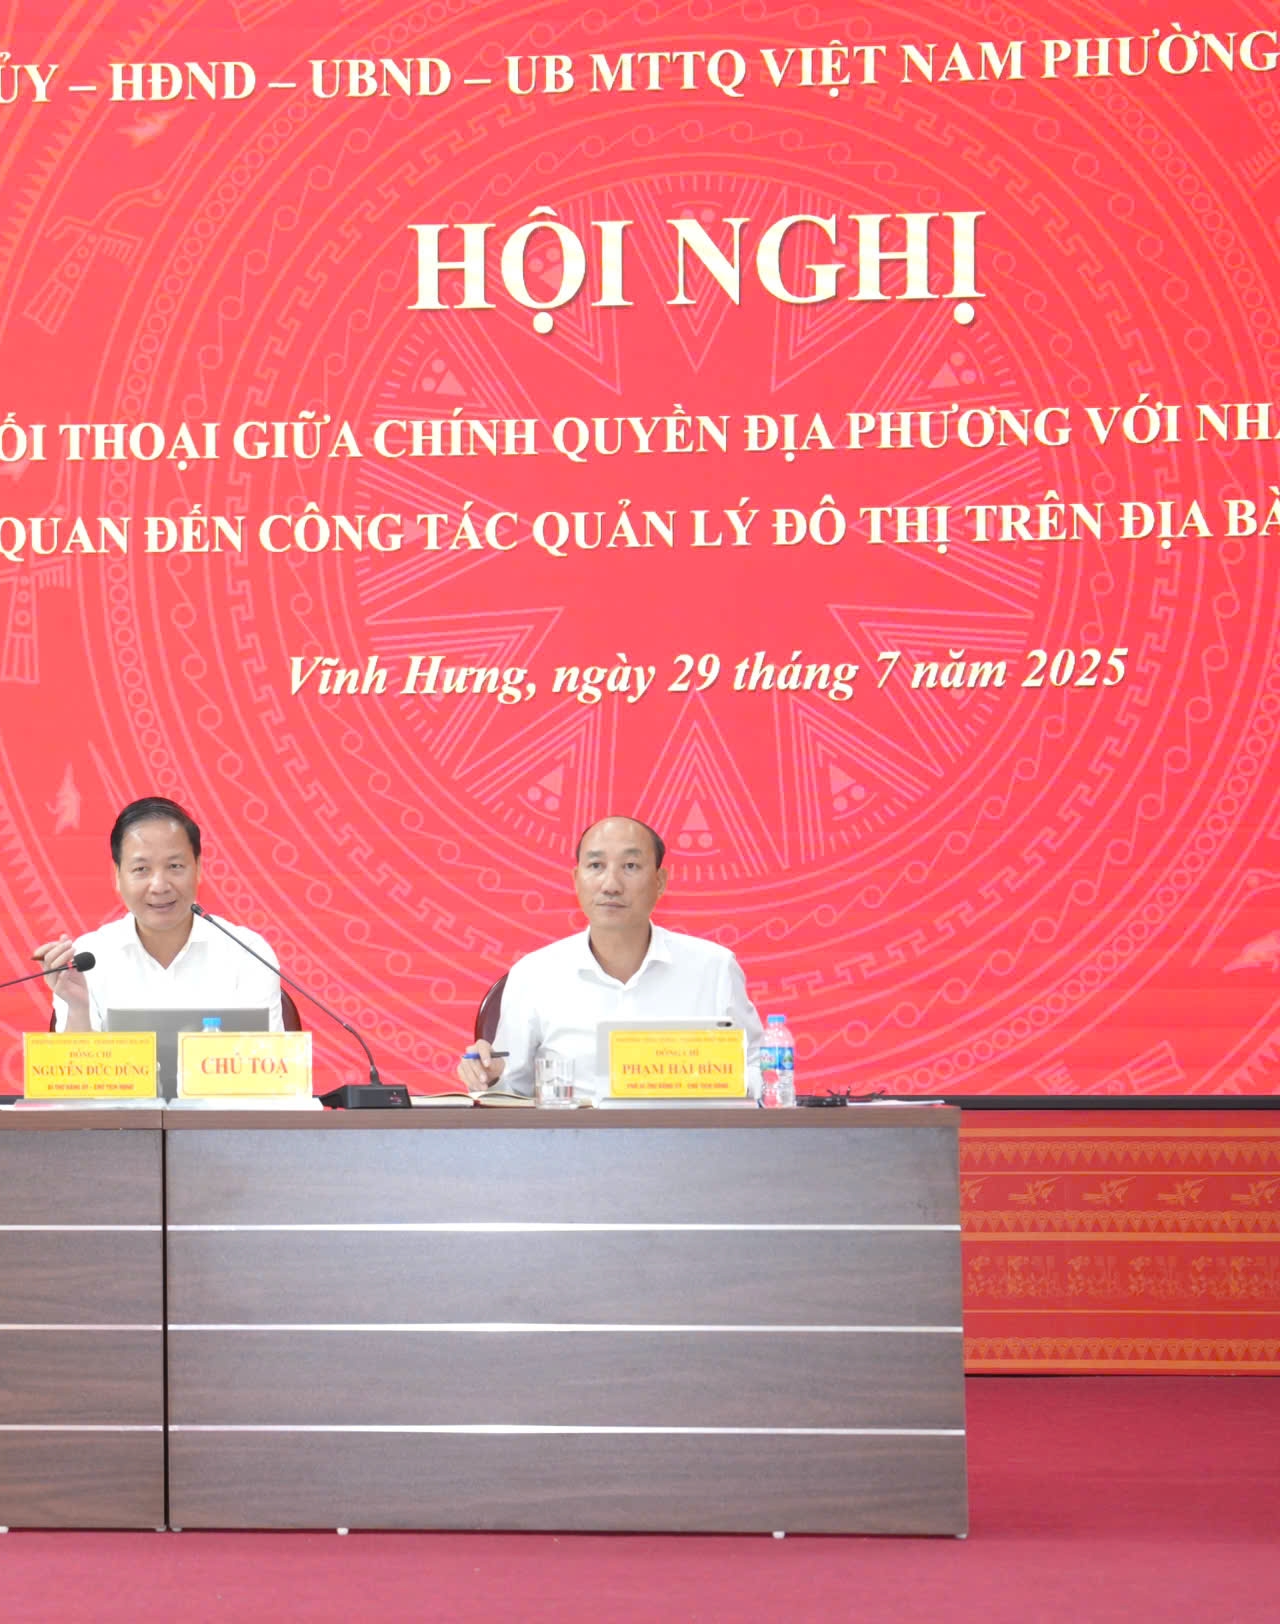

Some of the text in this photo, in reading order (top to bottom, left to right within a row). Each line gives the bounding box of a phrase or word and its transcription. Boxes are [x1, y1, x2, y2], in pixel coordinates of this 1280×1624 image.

[109, 61, 255, 101] HĐND
[310, 58, 451, 99] UBND
[505, 55, 574, 95] UB
[590, 50, 745, 97] MTTQ
[760, 40, 886, 97] VIỆT
[901, 41, 1025, 83] NAM
[1041, 22, 1280, 78] PHƯỜNG
[408, 206, 986, 333] HỘI NGHỊ
[59, 421, 219, 471] THOẠI
[234, 411, 363, 460] GIỮA
[374, 407, 537, 458] CHÍNH
[553, 403, 730, 462] QUYỀN
[744, 413, 835, 462] ĐỊA
[847, 404, 1072, 449] PHƯƠNG
[1085, 394, 1181, 444] VỚI
[1196, 403, 1280, 441] NH
[144, 503, 245, 553] ĐẾN
[259, 502, 404, 553] CÔNG
[417, 501, 518, 551] TÁC
[532, 498, 677, 557] QUẢN
[691, 496, 760, 547] LÝ
[773, 495, 846, 545] ĐÔ
[860, 506, 950, 554] THỊ
[965, 490, 1105, 542] TRÊN
[1119, 500, 1213, 550] ĐỊA
[290, 648, 1129, 705] Vĩnh Hưng, ngày 29 tháng 7 năm 2025
[201, 1052, 289, 1079] CHỦ TOẠ
